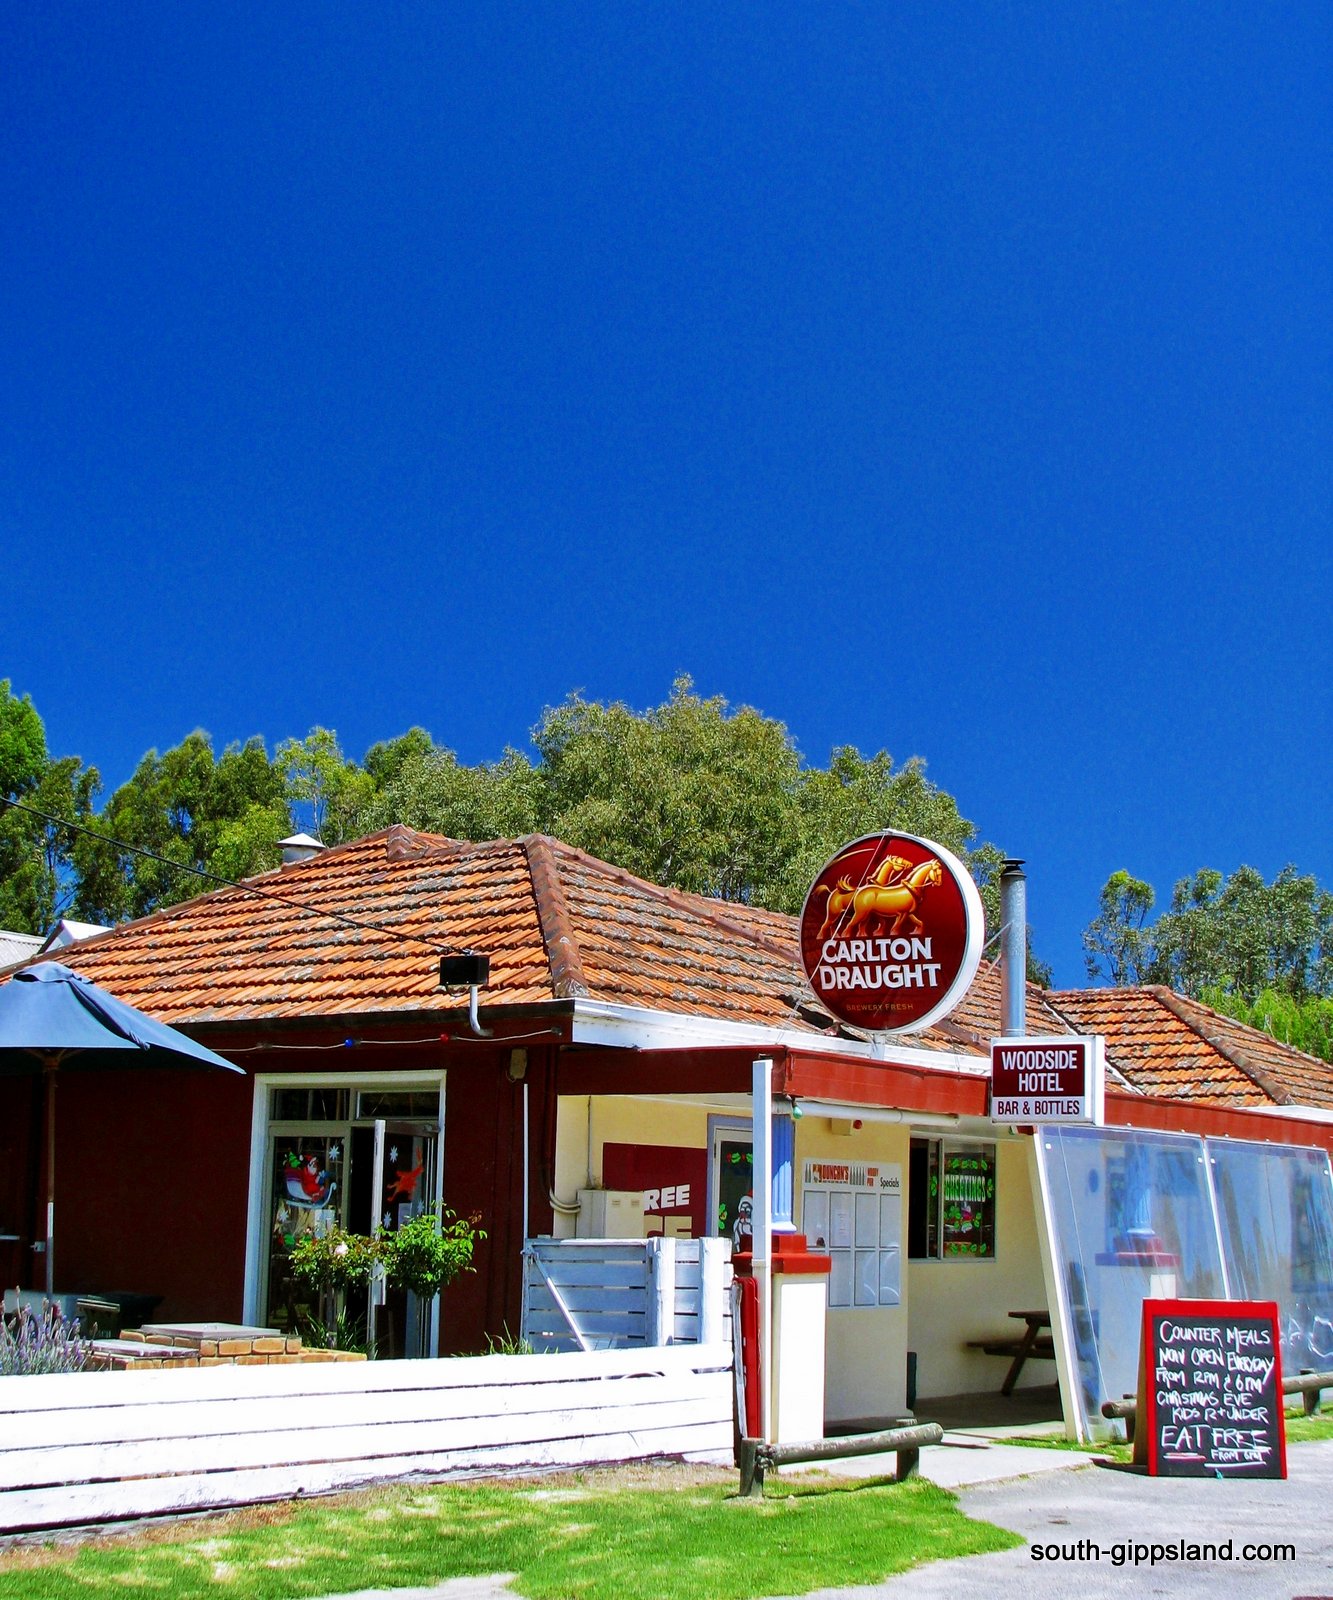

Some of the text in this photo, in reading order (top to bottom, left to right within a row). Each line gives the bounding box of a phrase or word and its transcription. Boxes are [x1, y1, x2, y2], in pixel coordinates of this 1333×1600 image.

[822, 937, 933, 963] CARLTON
[819, 963, 941, 990] DRAUGHT
[846, 1002, 914, 1012] BREWERY FRESH
[1001, 1049, 1077, 1070] WOODSIDE
[1018, 1072, 1064, 1092] HOTEL
[998, 1100, 1080, 1116] BAR & BOTTLES
[880, 1176, 900, 1190] Specials
[643, 1184, 691, 1212] REE
[1159, 1320, 1271, 1353] COUNTER MEALS
[1159, 1347, 1186, 1367] NOW
[1191, 1348, 1225, 1367] OPEN
[1156, 1367, 1186, 1389] FROM
[1156, 1390, 1253, 1407] CHRISTMAS EVE
[1172, 1407, 1200, 1425] KIDS
[1161, 1424, 1269, 1450] EAT FREE
[1211, 1448, 1239, 1462] FROM
